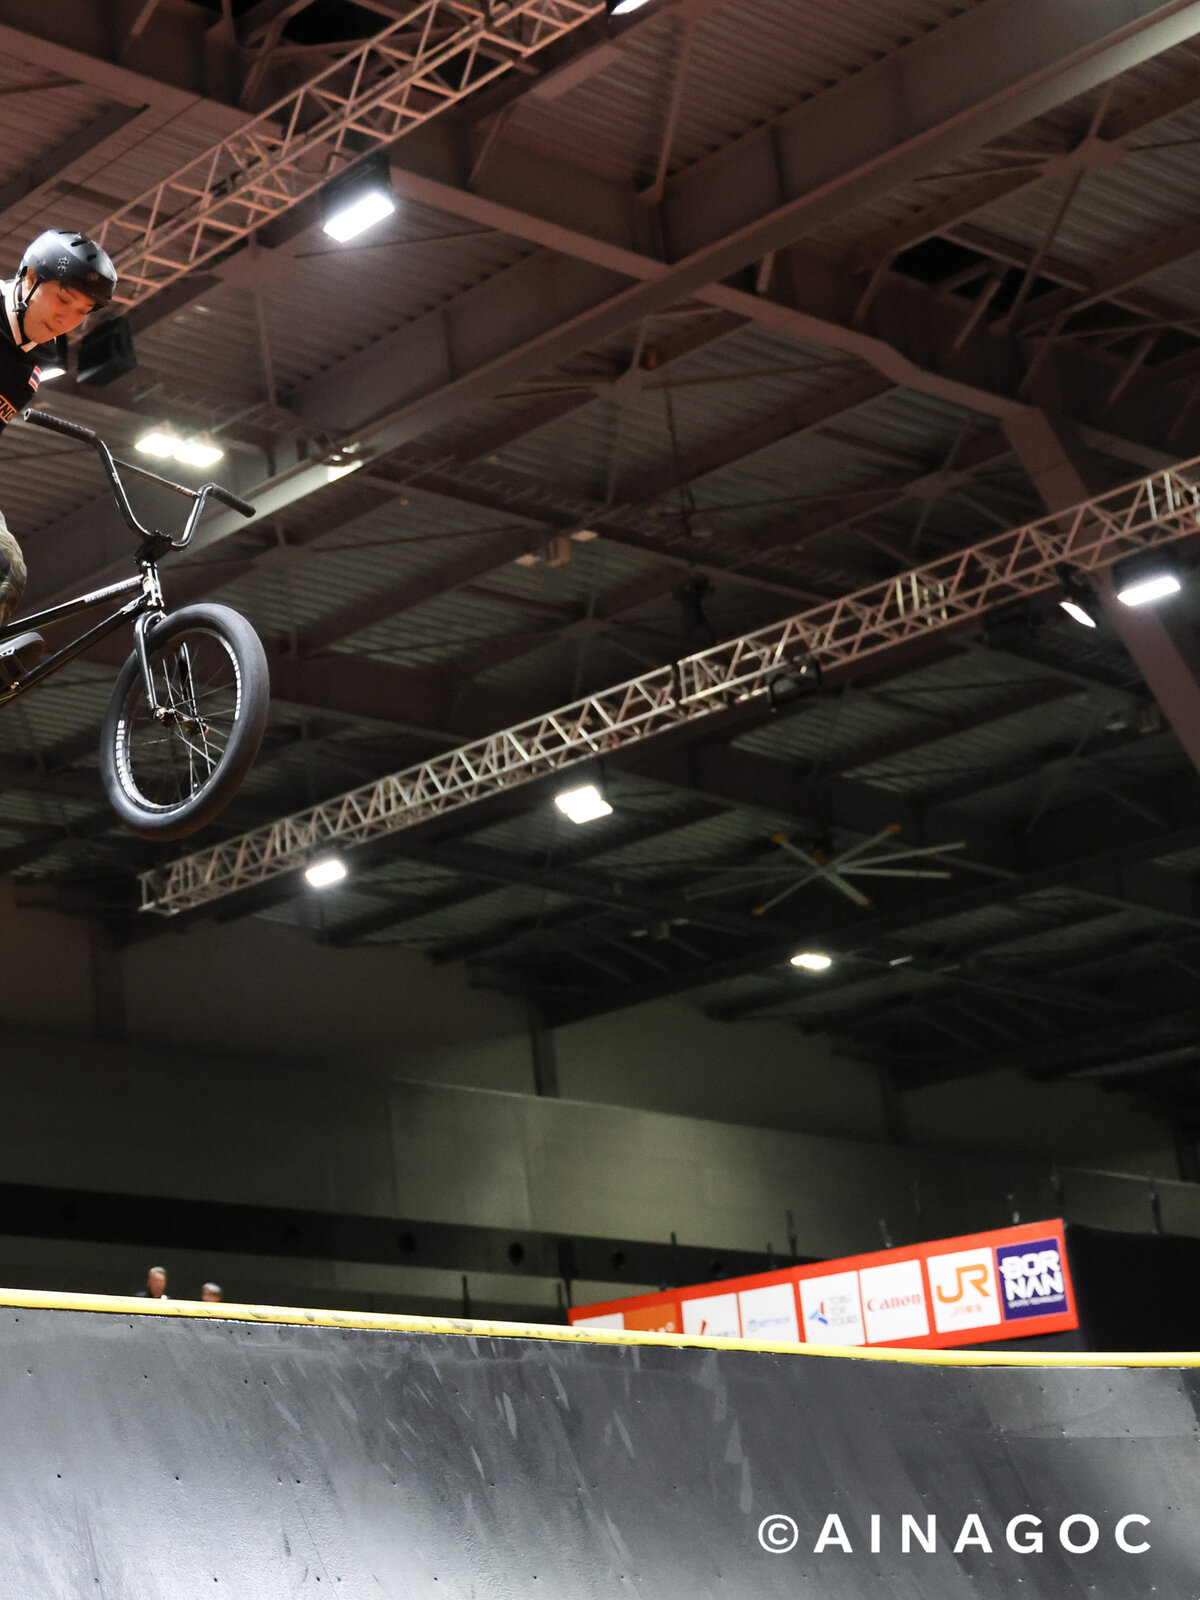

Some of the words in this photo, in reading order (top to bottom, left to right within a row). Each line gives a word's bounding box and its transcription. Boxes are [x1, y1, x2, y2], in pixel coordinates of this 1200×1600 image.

[999, 1249, 1061, 1279] BOR
[936, 1264, 990, 1304] JR
[1004, 1271, 1065, 1301] NAN
[867, 1293, 921, 1312] Canon
